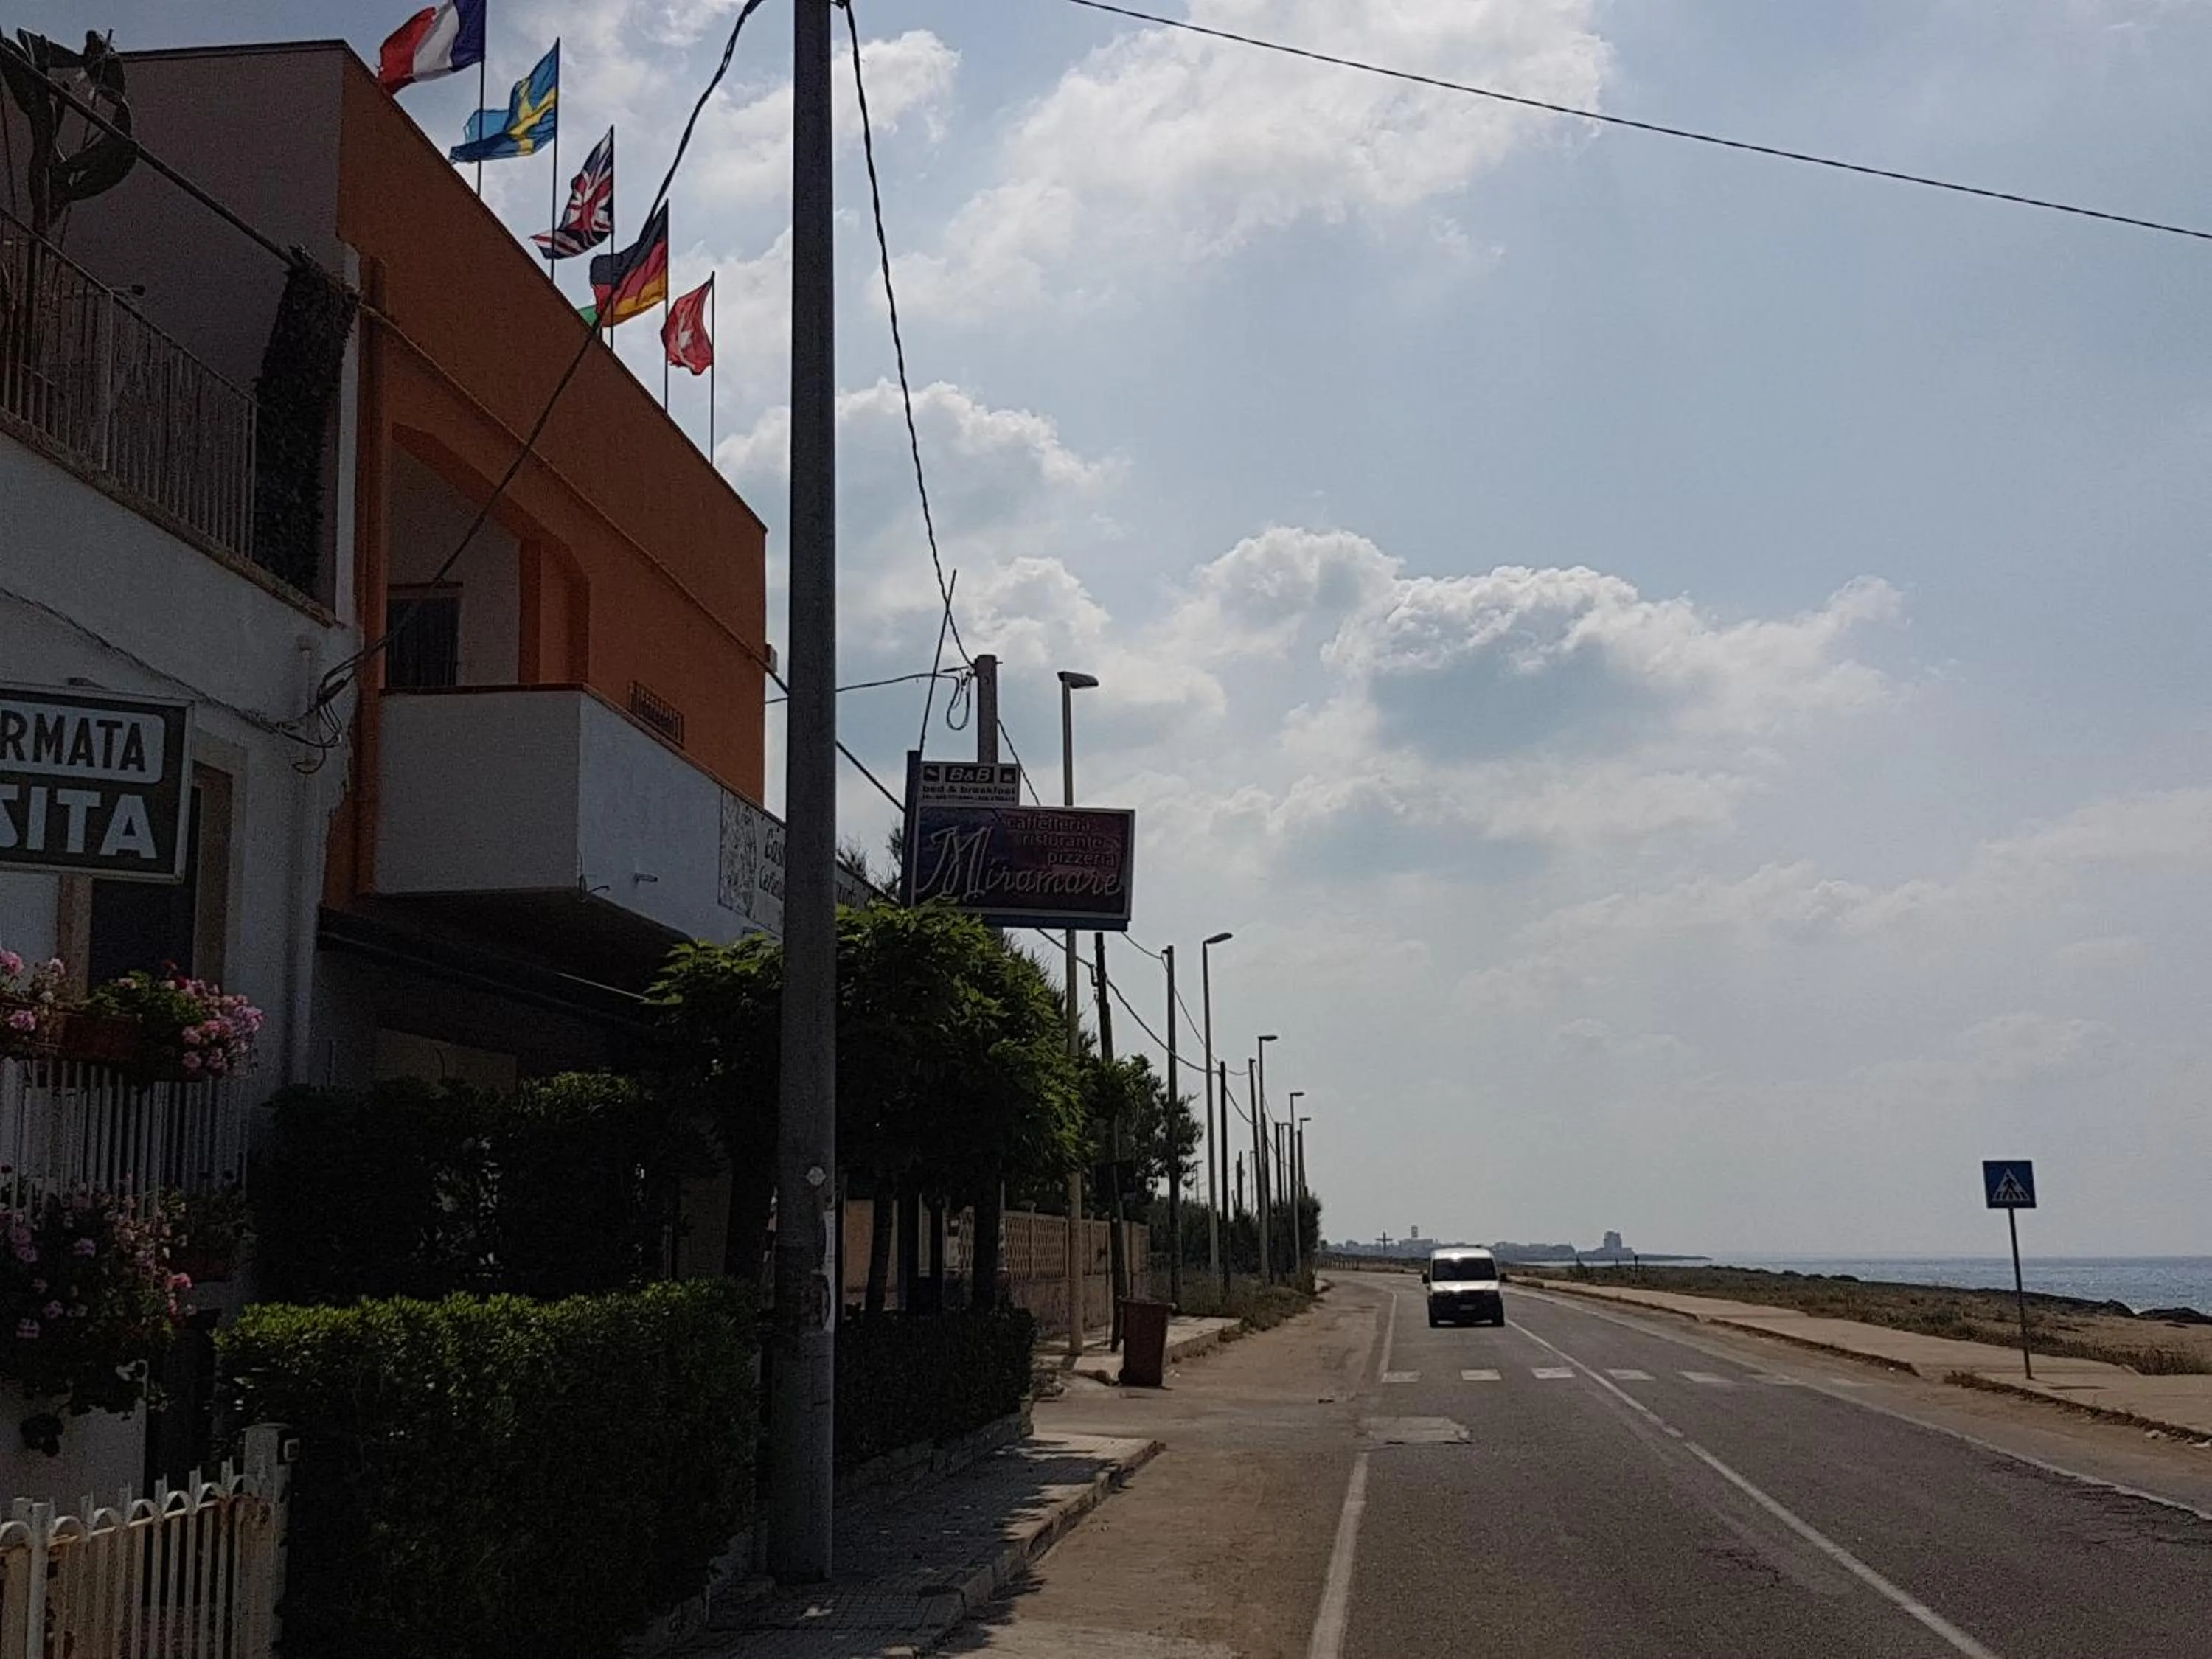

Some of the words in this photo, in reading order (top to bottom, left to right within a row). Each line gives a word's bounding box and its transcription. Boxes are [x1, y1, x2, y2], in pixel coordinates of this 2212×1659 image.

[949, 767, 992, 782] B&B
[922, 785, 945, 793] bed
[1047, 851, 1115, 866] pizzeria
